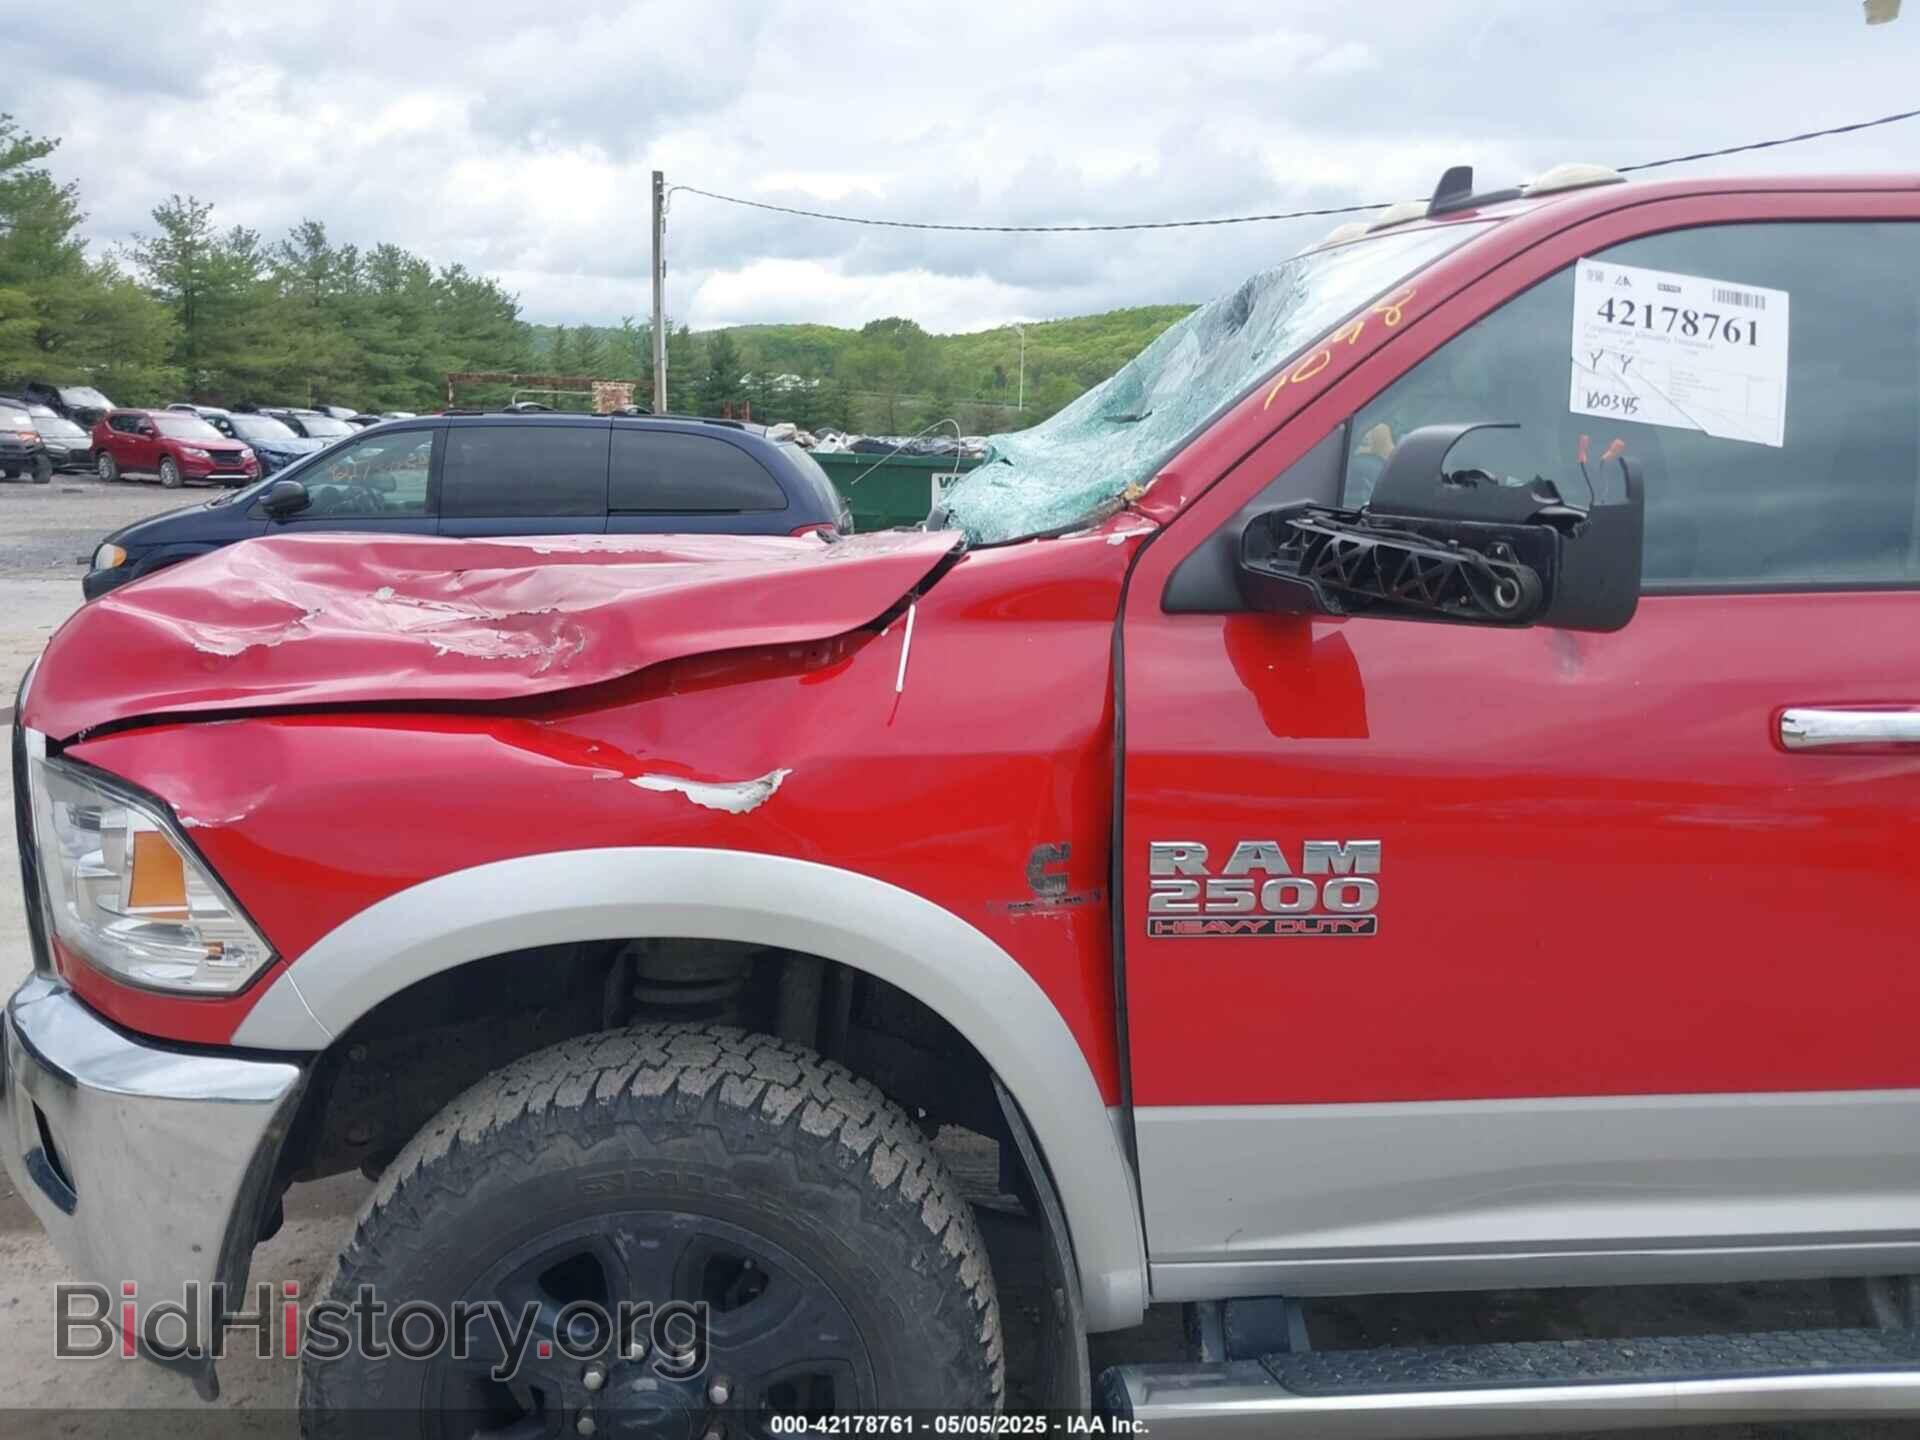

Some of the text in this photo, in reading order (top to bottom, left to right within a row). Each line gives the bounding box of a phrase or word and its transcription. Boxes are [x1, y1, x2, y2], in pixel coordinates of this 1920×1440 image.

[1597, 297, 1760, 348] 42178761
[1150, 840, 1382, 876] RAM
[1149, 877, 1380, 913] 2500
[1154, 919, 1370, 935] HEAVY DUTY
